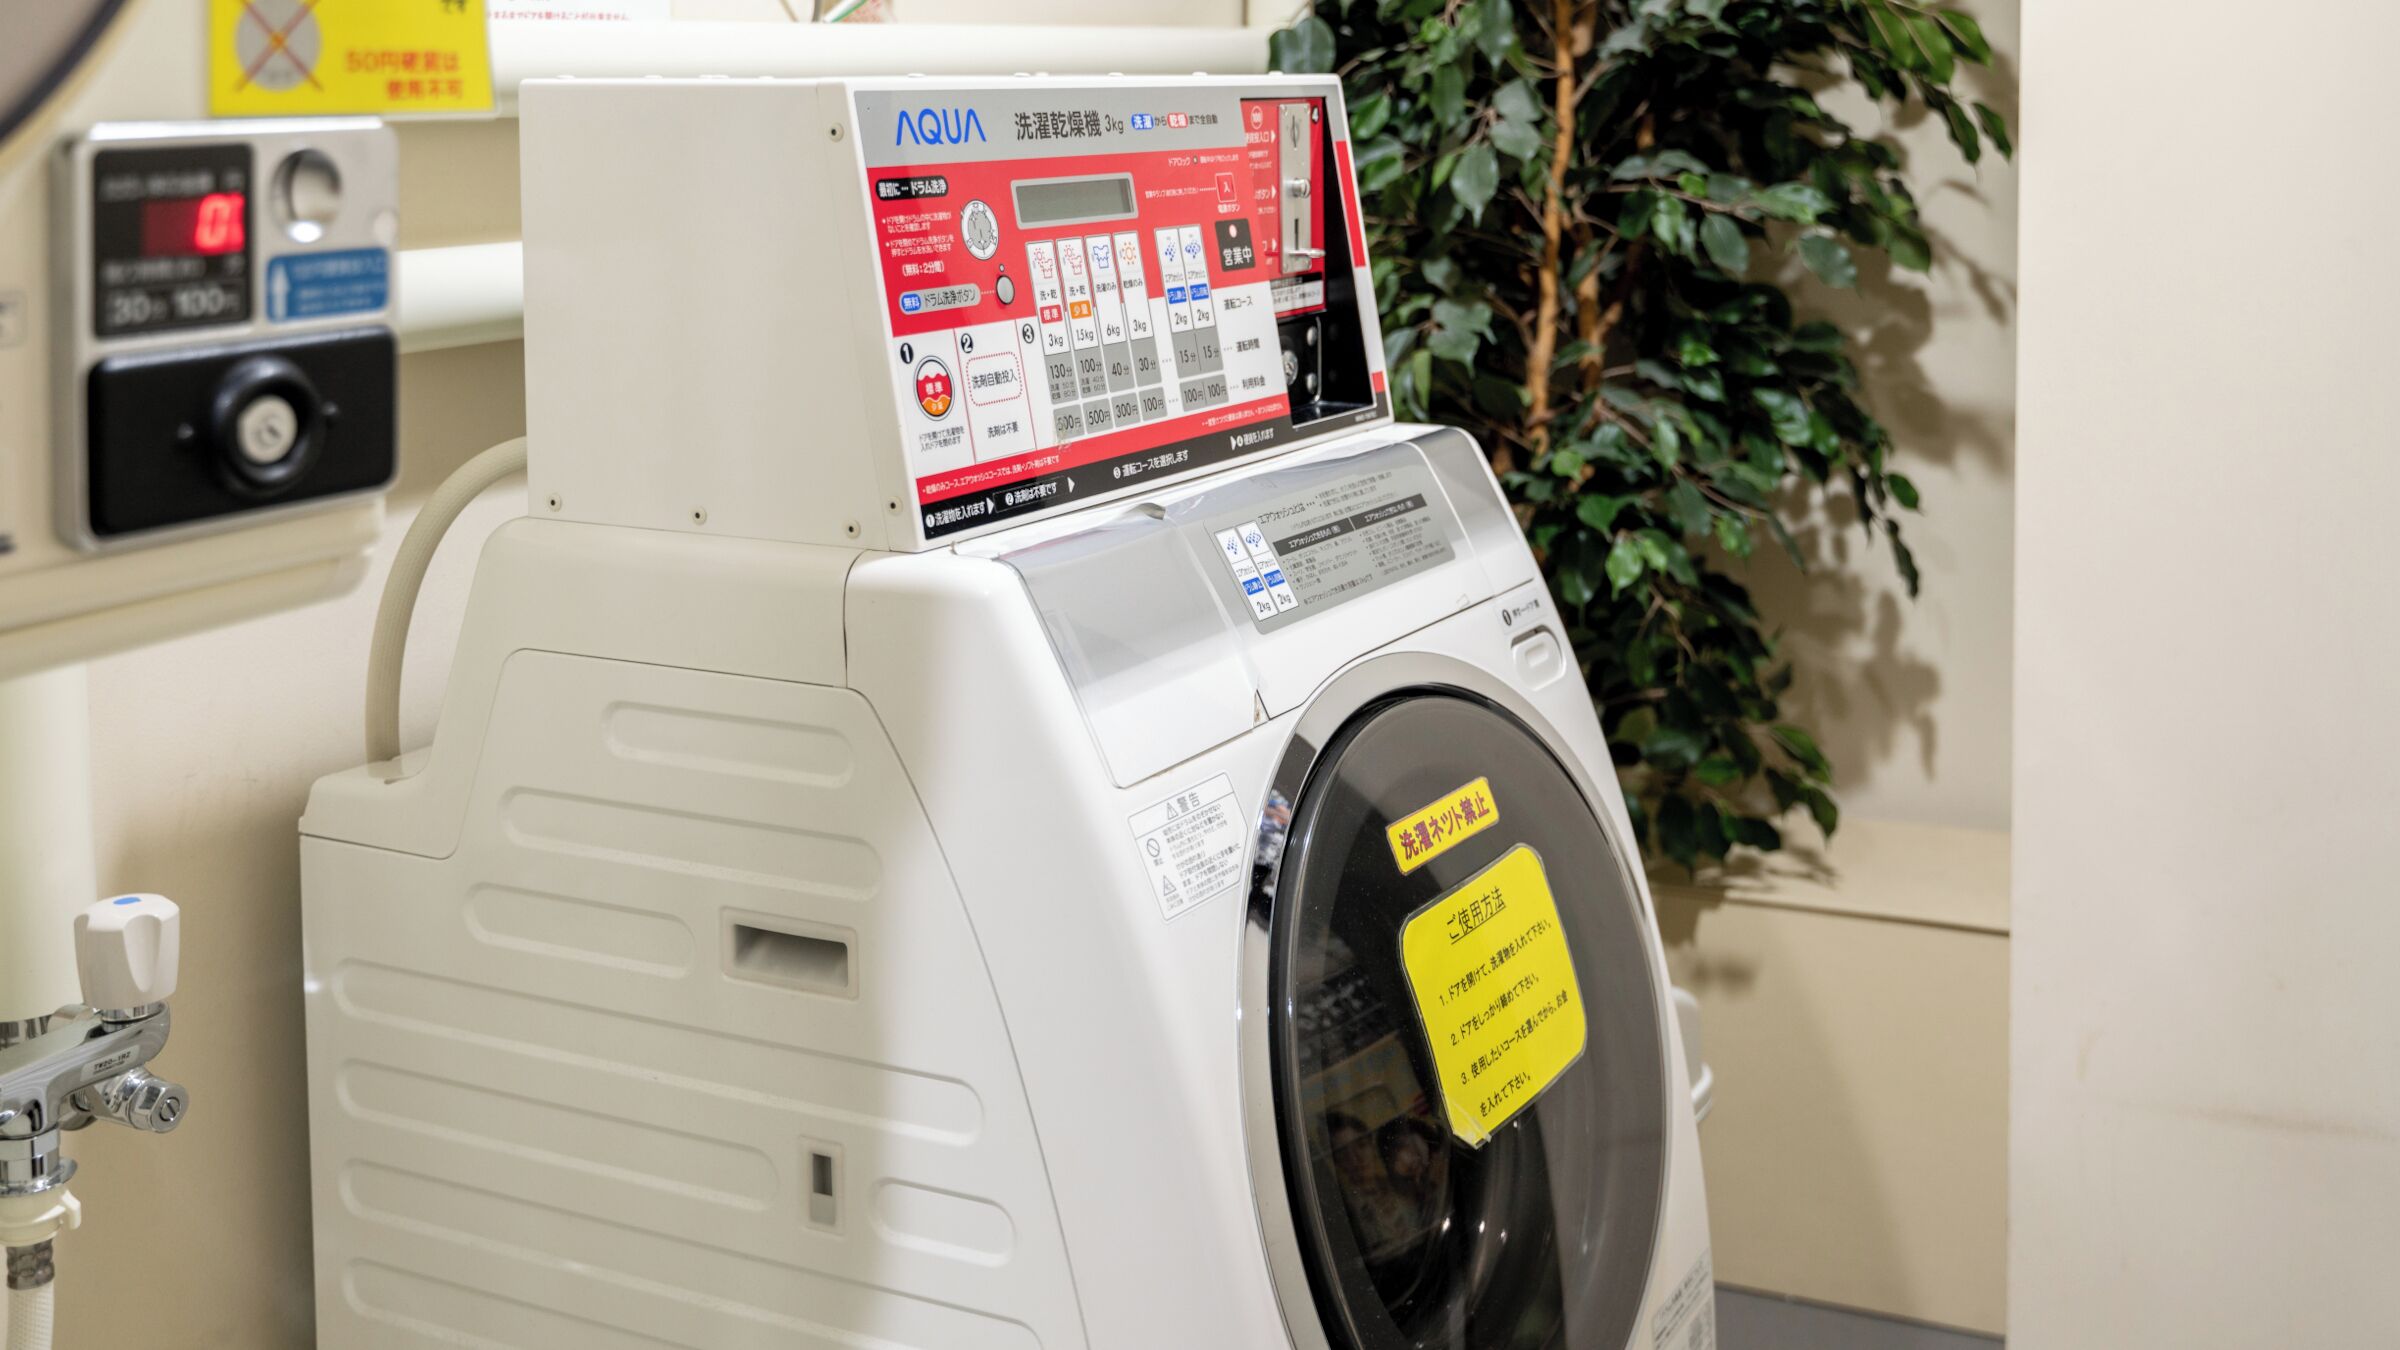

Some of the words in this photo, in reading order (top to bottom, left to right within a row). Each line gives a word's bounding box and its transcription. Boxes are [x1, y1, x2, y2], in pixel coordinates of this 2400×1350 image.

[896, 108, 987, 146] AQUA
[1014, 111, 1102, 141] 洗濯乾燥機
[1105, 115, 1124, 134] 3kg
[1222, 246, 1252, 266] 営業中
[924, 289, 976, 308] ドラム洗浄ボタン
[1043, 308, 1060, 321] 標準
[1174, 312, 1187, 326] 2kg
[1196, 309, 1210, 322] 2kg
[1106, 323, 1120, 338] 6kg
[1133, 319, 1147, 333] 3kg
[1048, 333, 1064, 348] 3kg
[1179, 349, 1196, 364] 15分
[1203, 345, 1219, 359] 15分
[1050, 364, 1073, 379] 130分
[1080, 358, 1102, 374] 100分
[1111, 362, 1130, 377] 40分
[1138, 357, 1156, 372] 30分
[971, 368, 1018, 390] 洗剤自動投入
[1184, 388, 1204, 404] 100円
[1207, 383, 1228, 399] 100円
[1115, 403, 1138, 419] 300円
[1143, 397, 1164, 412] 100円
[1088, 408, 1110, 425] 500円
[986, 421, 1020, 439] 洗剤は不要
[1122, 450, 1189, 476] 運転コースを選択します
[1014, 482, 1057, 504] 洗剤は不要です
[1256, 600, 1271, 614] 2kg
[1278, 592, 1292, 606] 2kg
[1177, 791, 1200, 813] 警告
[1446, 886, 1506, 940] ご使用方法
[1448, 918, 1552, 1001] ドアを開けて、洗濯物を入れて下さい。
[1470, 989, 1569, 1080] 使用したいコースを選んでから、お金
[1479, 1071, 1532, 1118] を入れて下さい。
